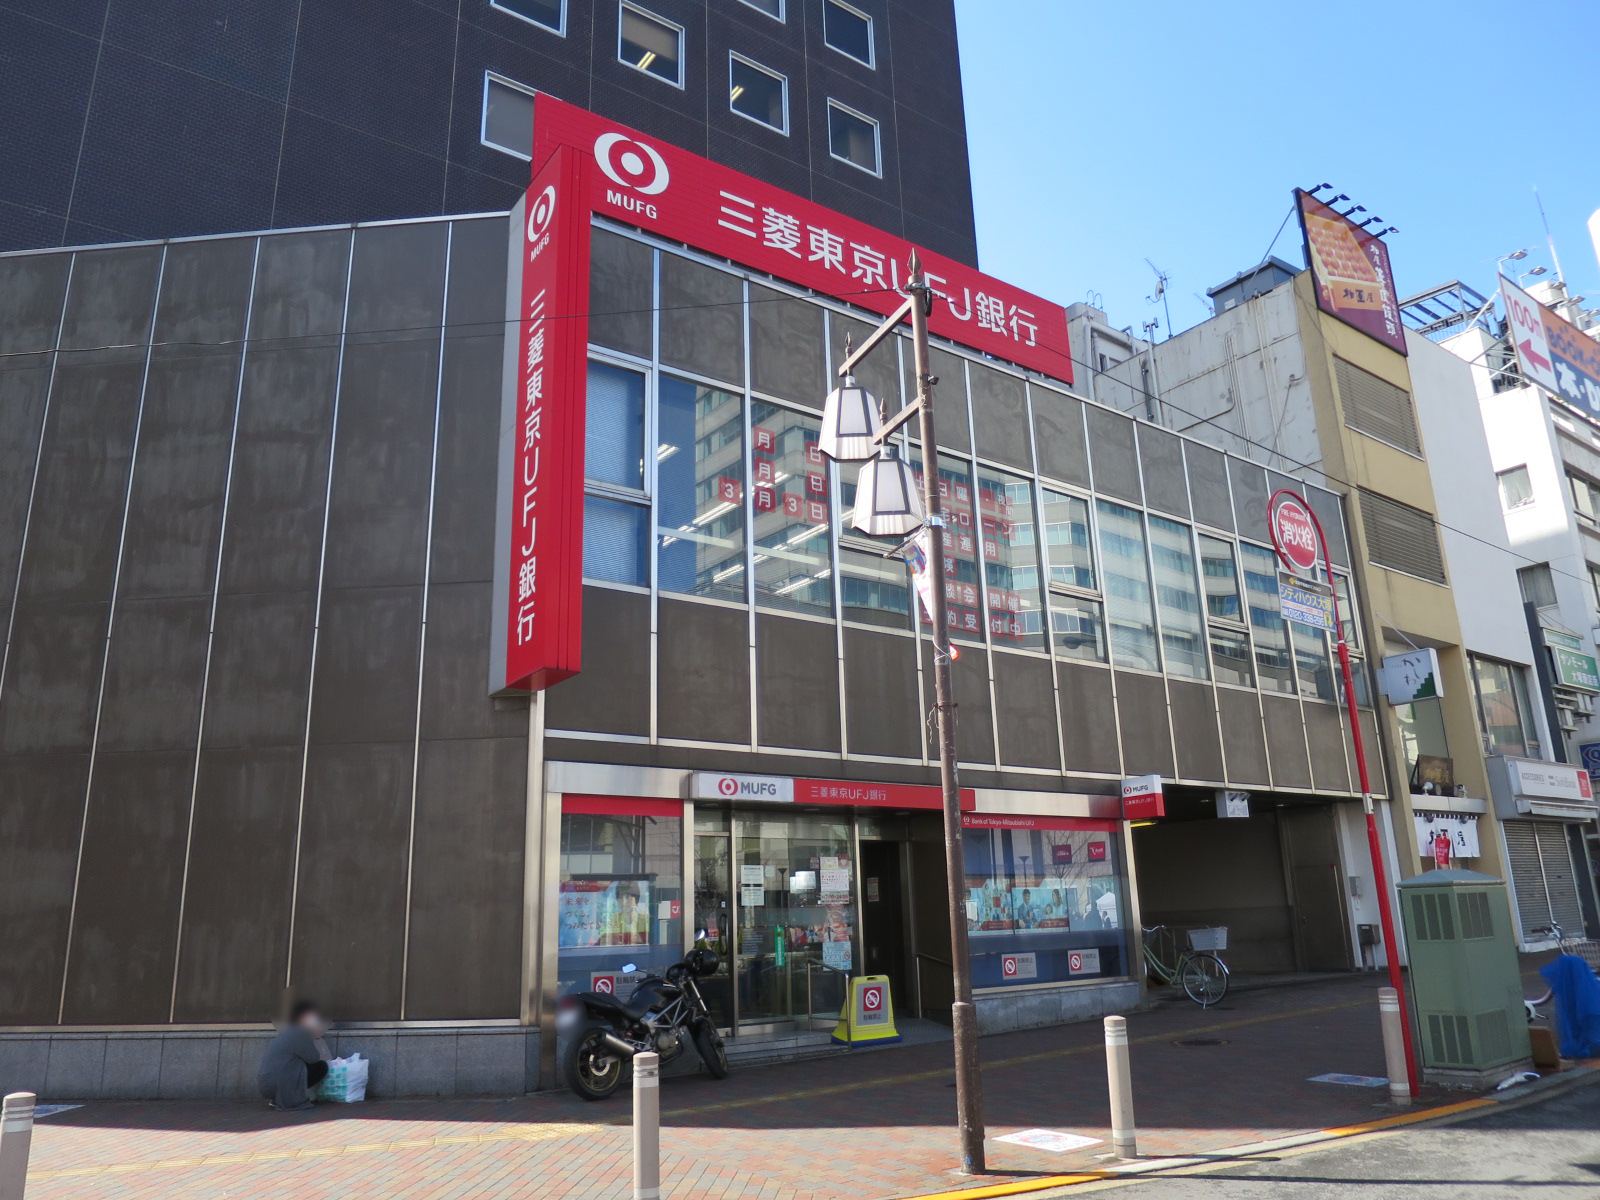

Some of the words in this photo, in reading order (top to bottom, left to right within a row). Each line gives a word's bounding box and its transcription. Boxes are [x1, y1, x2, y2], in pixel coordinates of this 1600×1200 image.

[606, 189, 658, 220] MUFG
[530, 232, 550, 262] MUFG
[758, 431, 770, 449] 月
[516, 289, 546, 646] 三菱東京UFJ銀行
[758, 462, 771, 479] 月
[811, 475, 823, 491] 日
[1279, 518, 1315, 551] 消火栓
[945, 584, 1021, 611] 談会開催
[740, 782, 777, 796] MUFG
[811, 786, 887, 801] 三菱東京UFJ銀行
[1132, 785, 1149, 793] MUFG
[988, 819, 1025, 827] Tokyo-Mitsubishi
